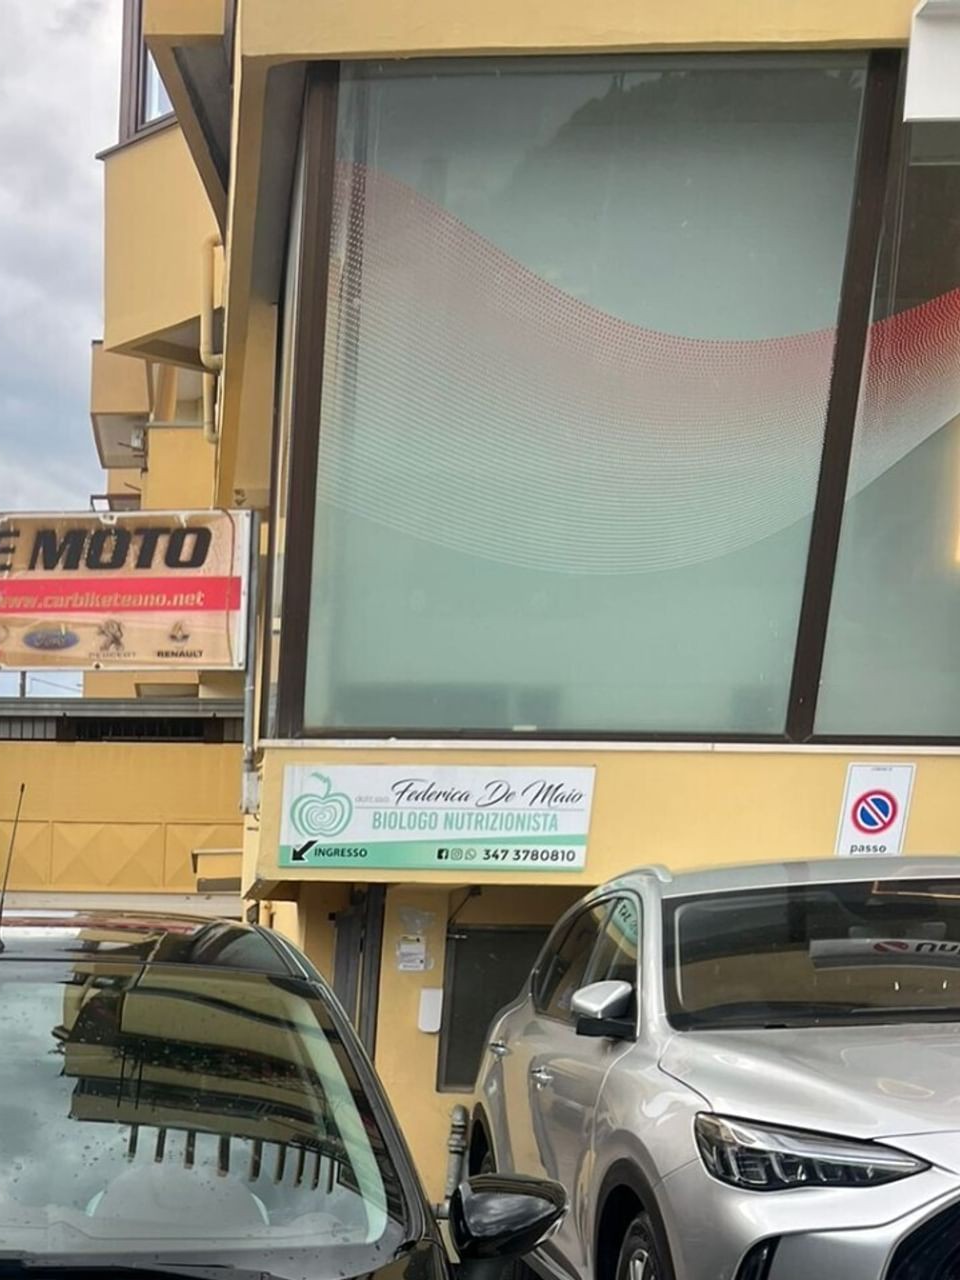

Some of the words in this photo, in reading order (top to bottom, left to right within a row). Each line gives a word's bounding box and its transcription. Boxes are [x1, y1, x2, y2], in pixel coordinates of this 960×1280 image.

[27, 525, 213, 571] MOTO
[156, 650, 204, 658] RENAULT
[390, 778, 471, 806] Federica
[475, 779, 518, 808] De
[521, 778, 585, 807] Maio
[371, 811, 439, 830] BIOLOGO
[443, 811, 559, 832] NUTRIZIONISTA
[313, 847, 368, 859] INGRESSO
[482, 849, 510, 861] 347
[512, 849, 576, 863] 3780810
[849, 844, 887, 855] passo
